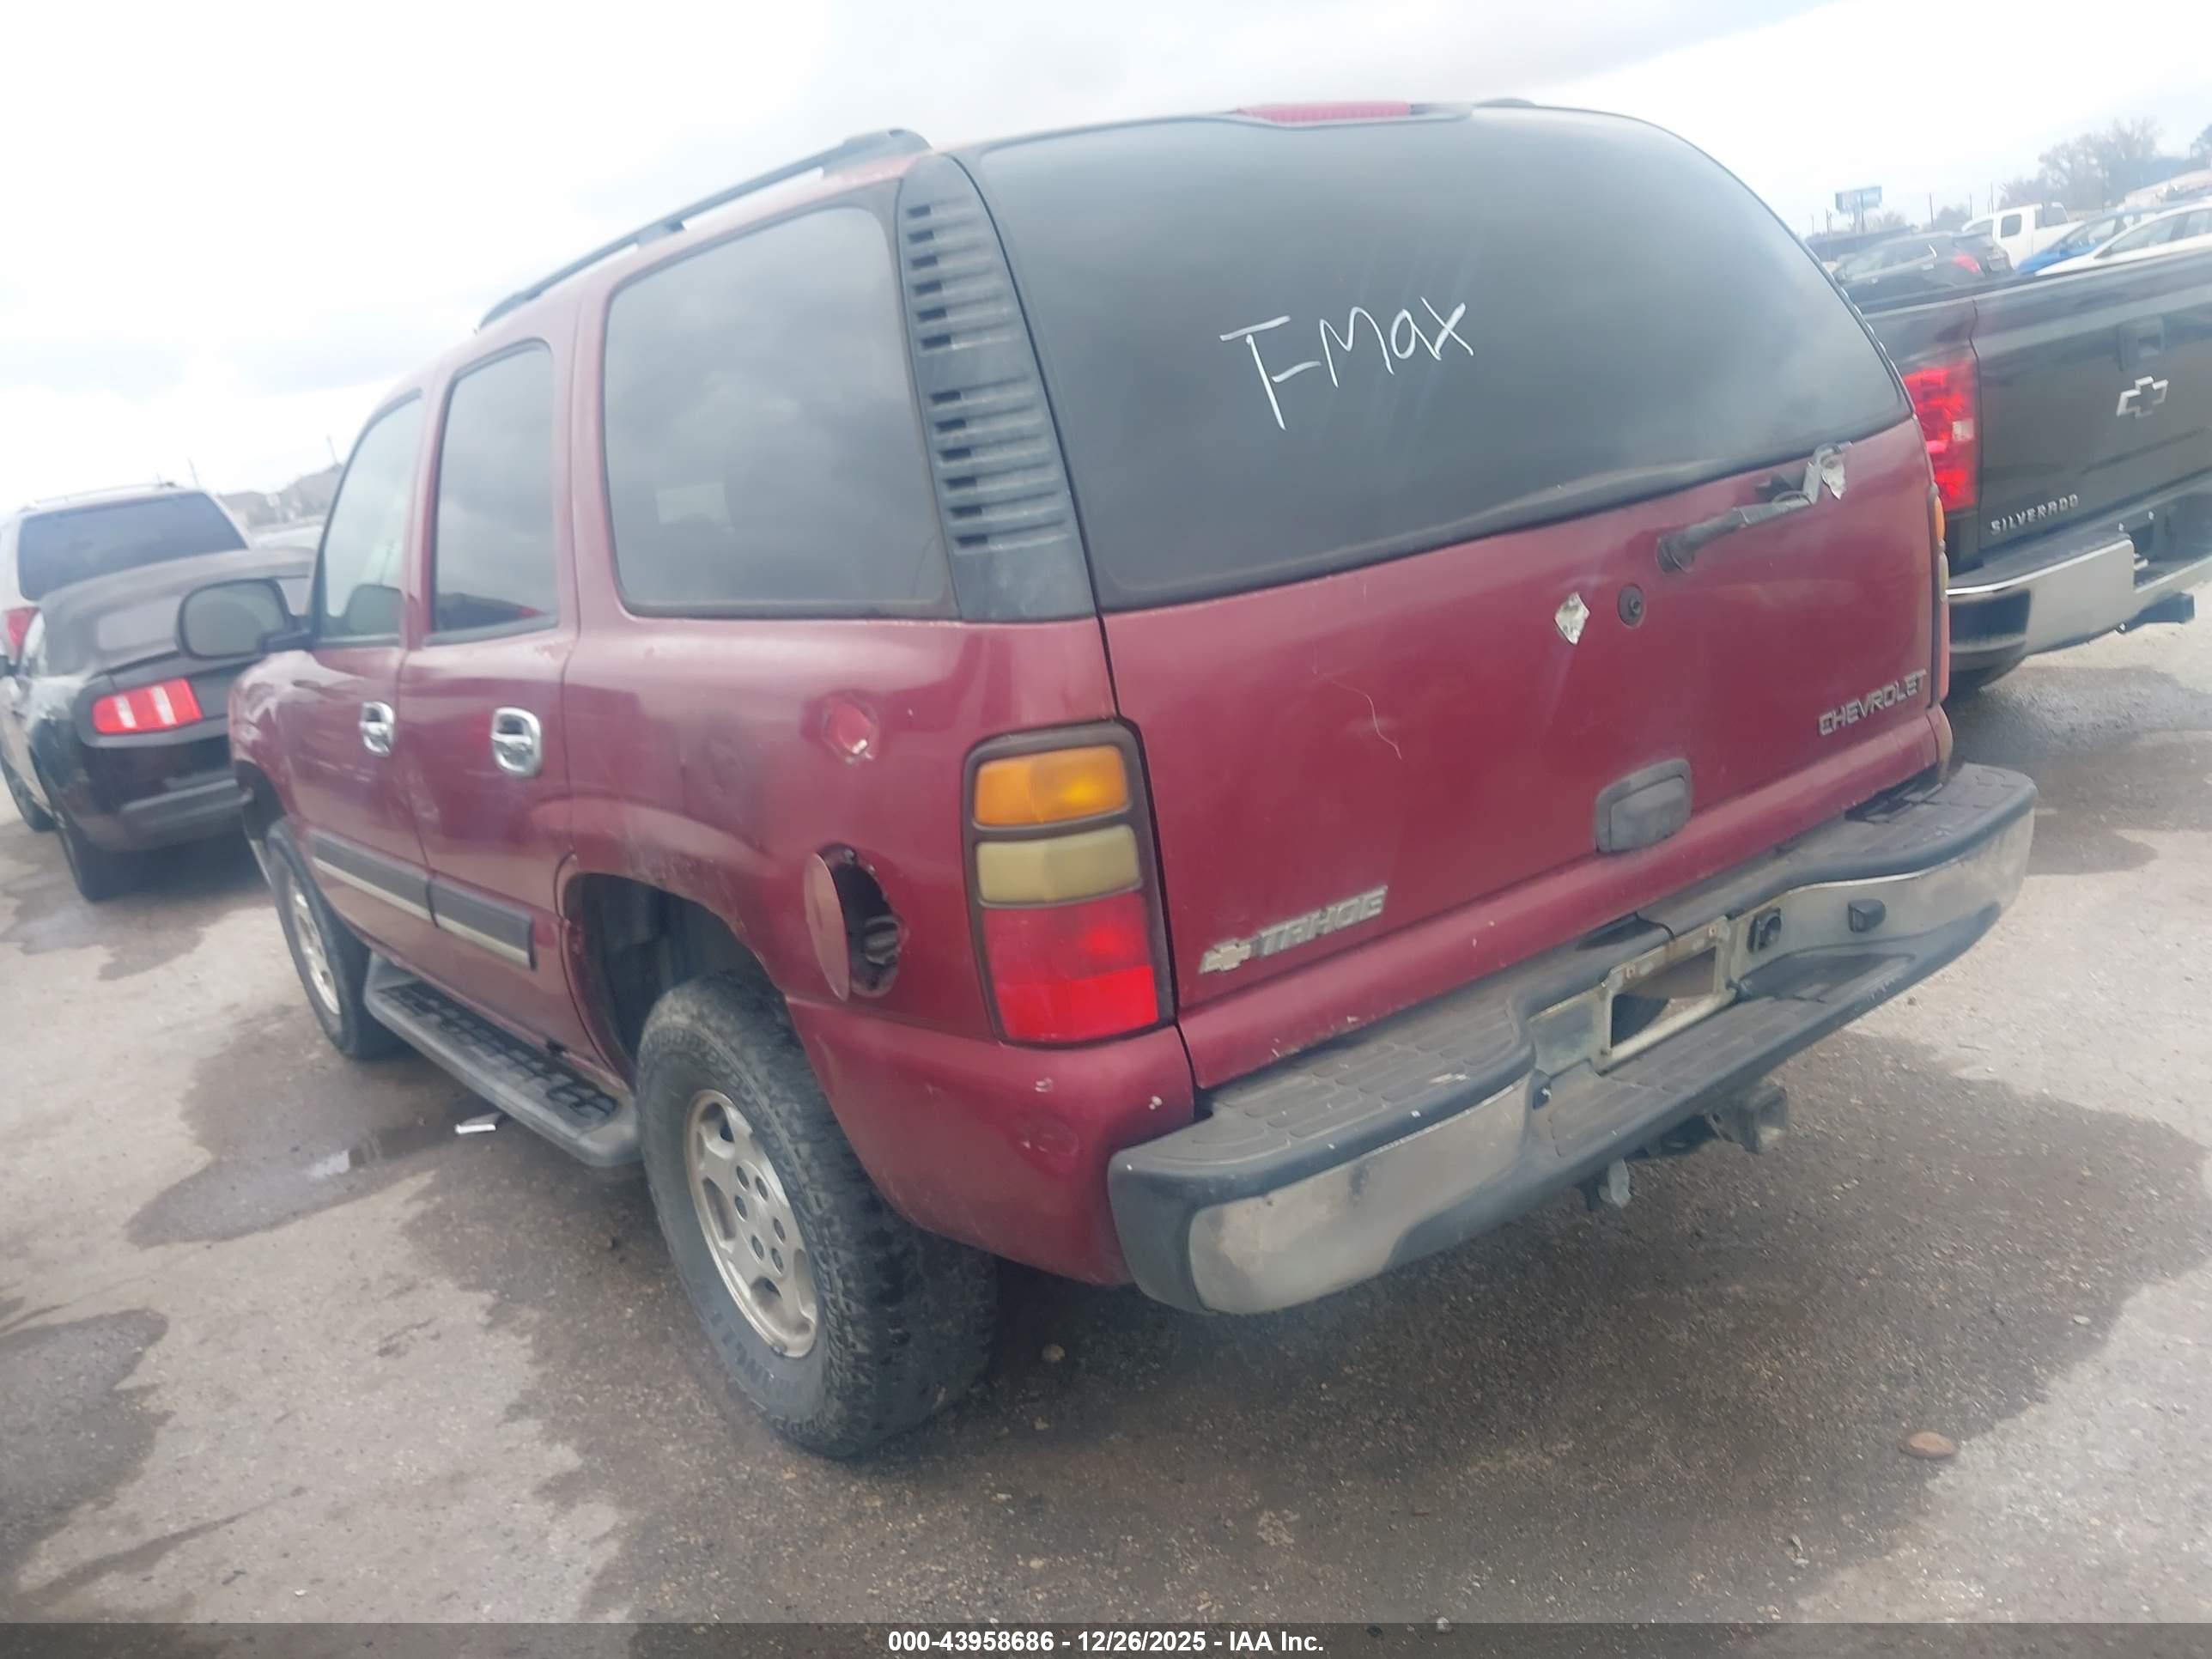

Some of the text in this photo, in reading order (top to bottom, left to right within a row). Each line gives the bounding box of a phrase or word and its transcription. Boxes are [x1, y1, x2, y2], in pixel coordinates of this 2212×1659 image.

[1990, 494, 2079, 534] SILVERADO
[1819, 670, 1927, 736] CHEVROLET
[1259, 884, 1388, 956] TAHOE
